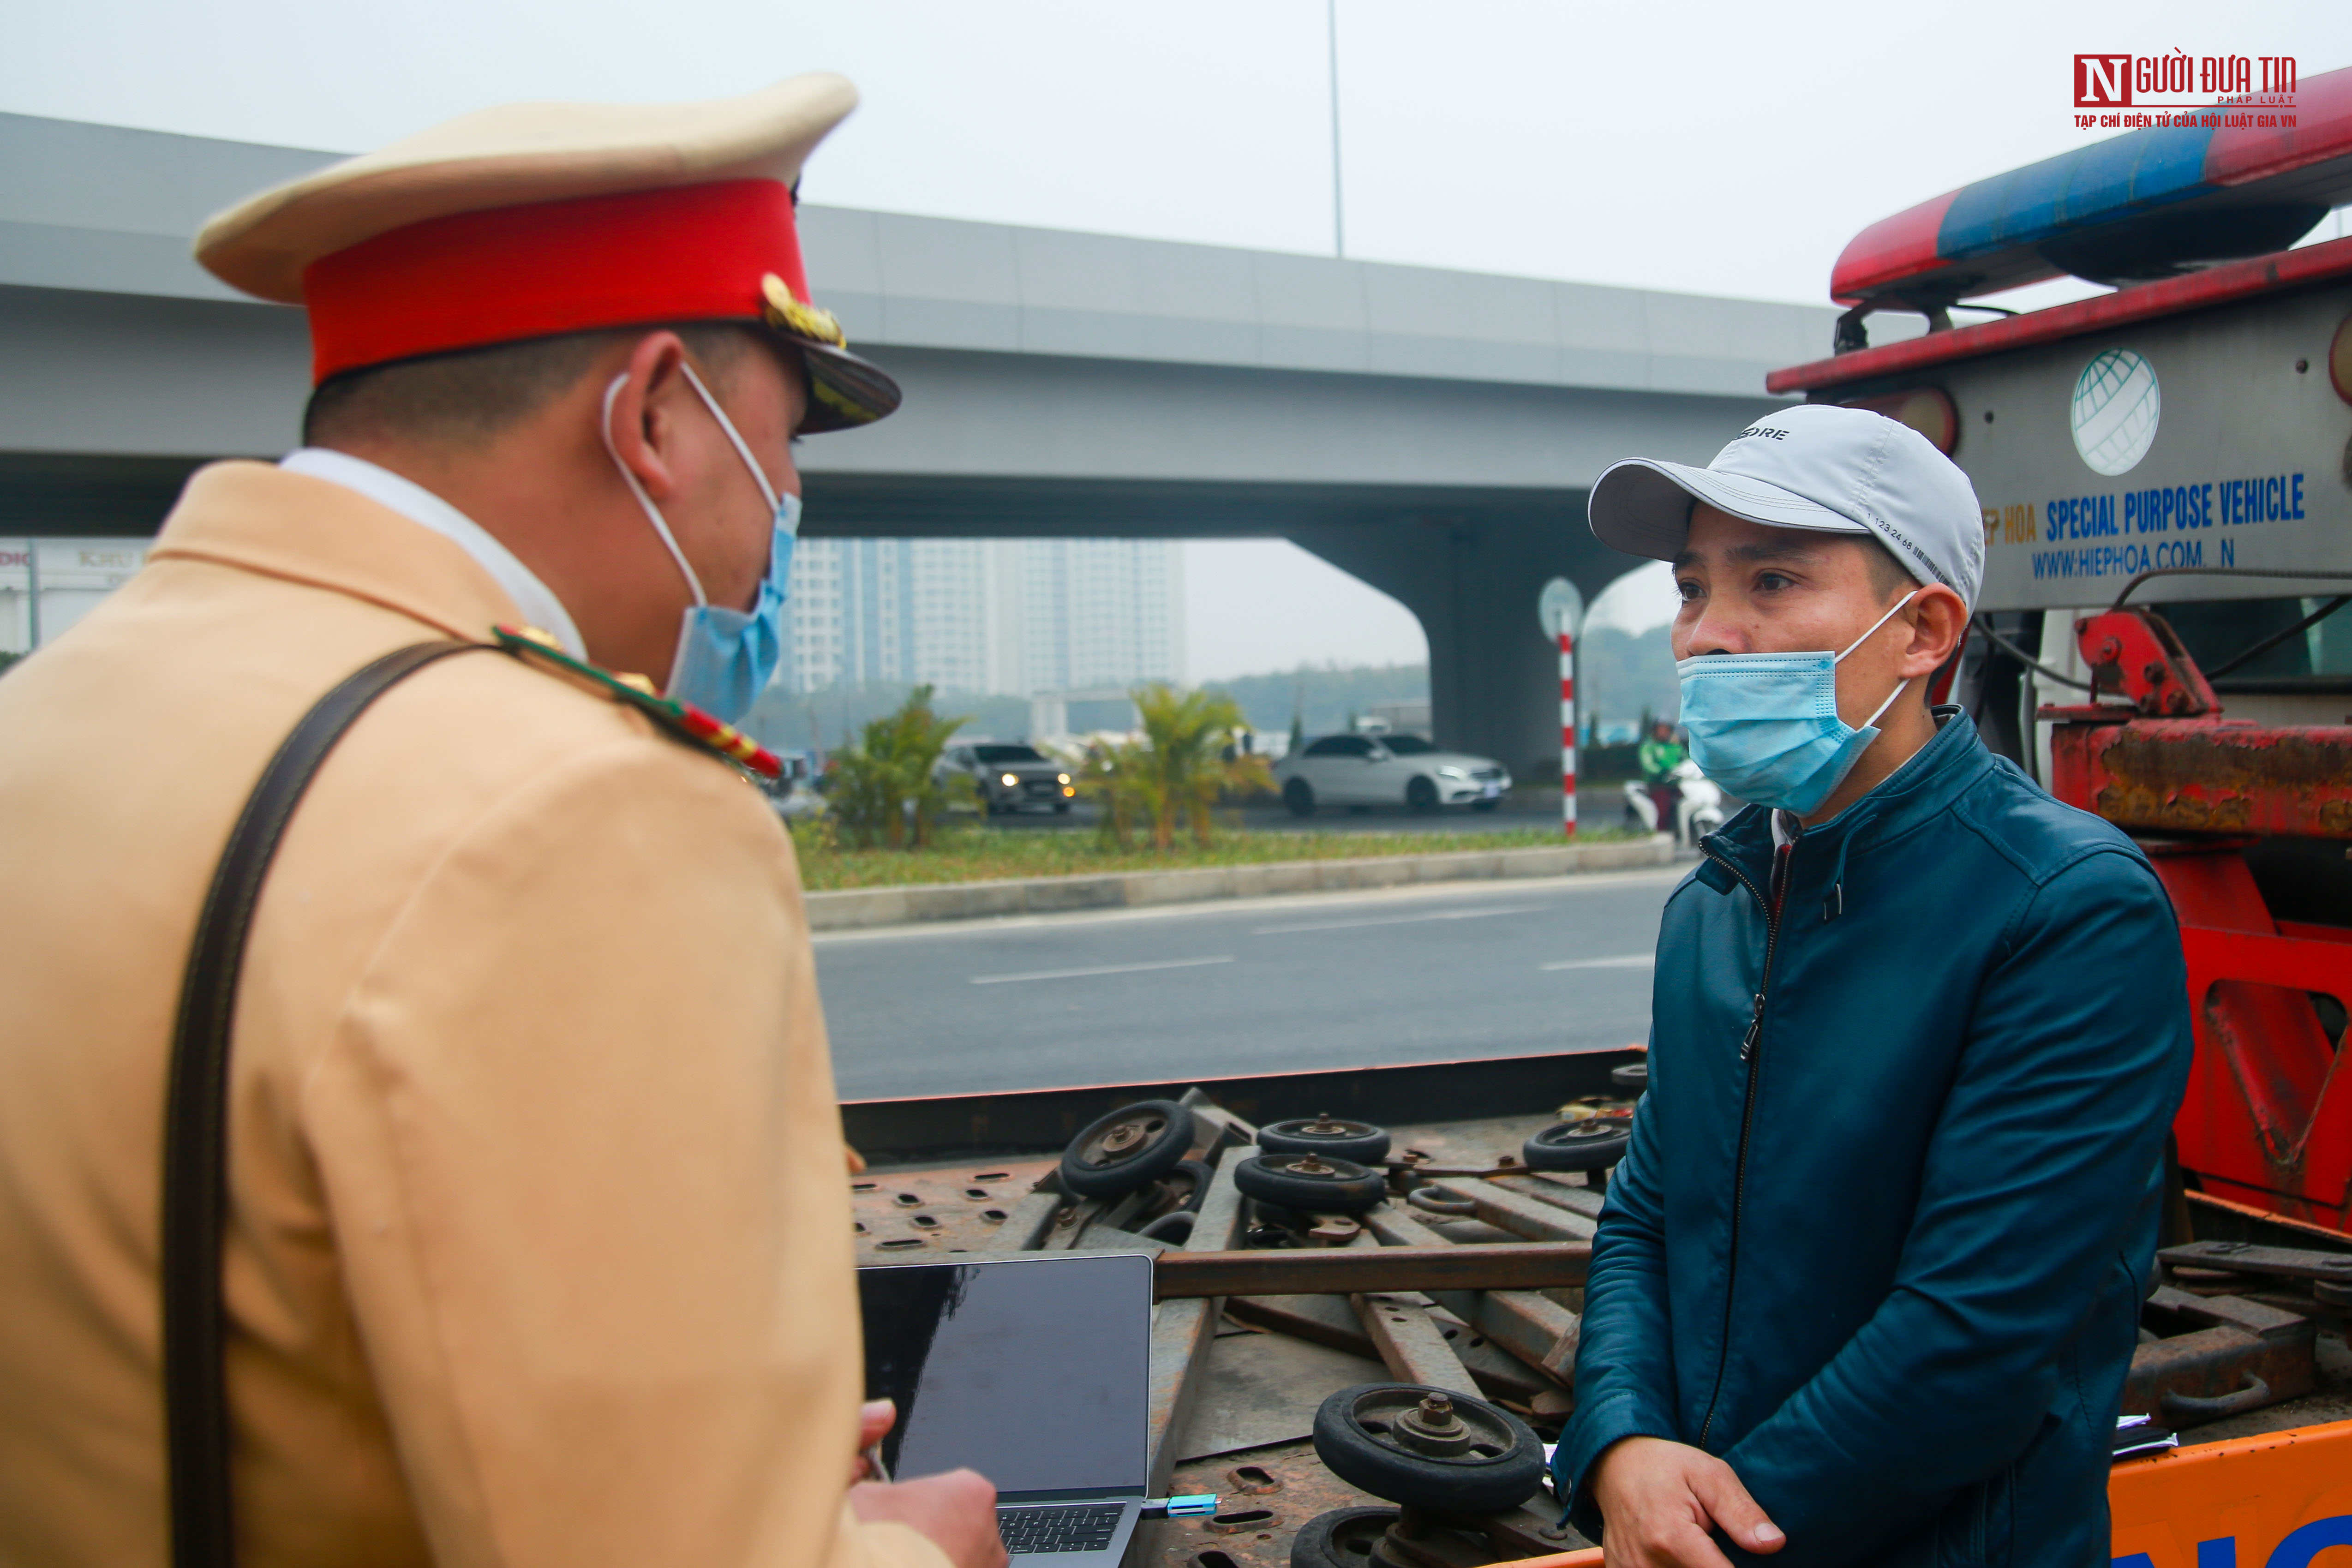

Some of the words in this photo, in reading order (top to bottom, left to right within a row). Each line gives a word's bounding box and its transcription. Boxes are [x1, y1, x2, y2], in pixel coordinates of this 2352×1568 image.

[2005, 503, 2037, 545] HOA
[2047, 495, 2119, 542] SPECIAL
[2125, 483, 2213, 534] PURPOSE
[2220, 473, 2305, 526] VEHICLE
